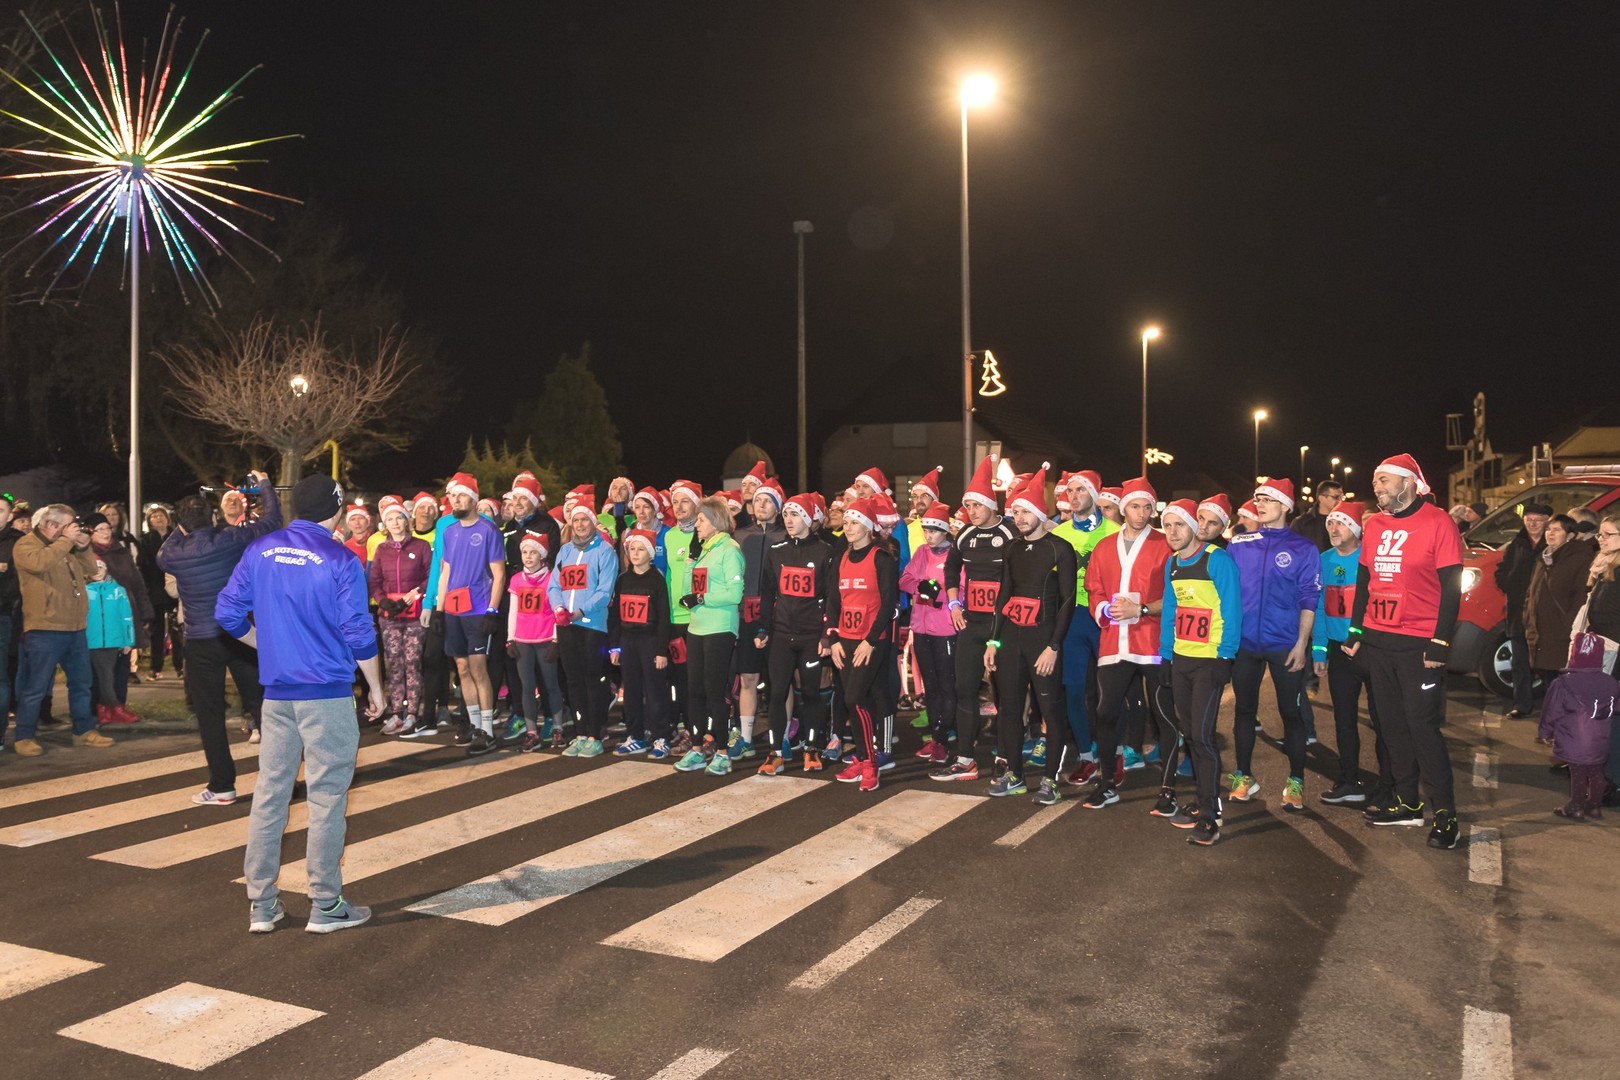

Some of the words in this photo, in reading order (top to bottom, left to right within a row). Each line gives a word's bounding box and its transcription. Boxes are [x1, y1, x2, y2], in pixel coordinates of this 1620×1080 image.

[1376, 529, 1408, 556] 32
[1374, 562, 1402, 573] STAREK
[562, 569, 586, 587] 162
[783, 573, 812, 594] 163
[453, 595, 459, 612] 1
[519, 592, 542, 611] 161
[971, 588, 997, 608] 139
[621, 601, 647, 619] 167
[1007, 603, 1034, 625] 137
[1372, 598, 1398, 621] 117
[1177, 613, 1209, 639] 178
